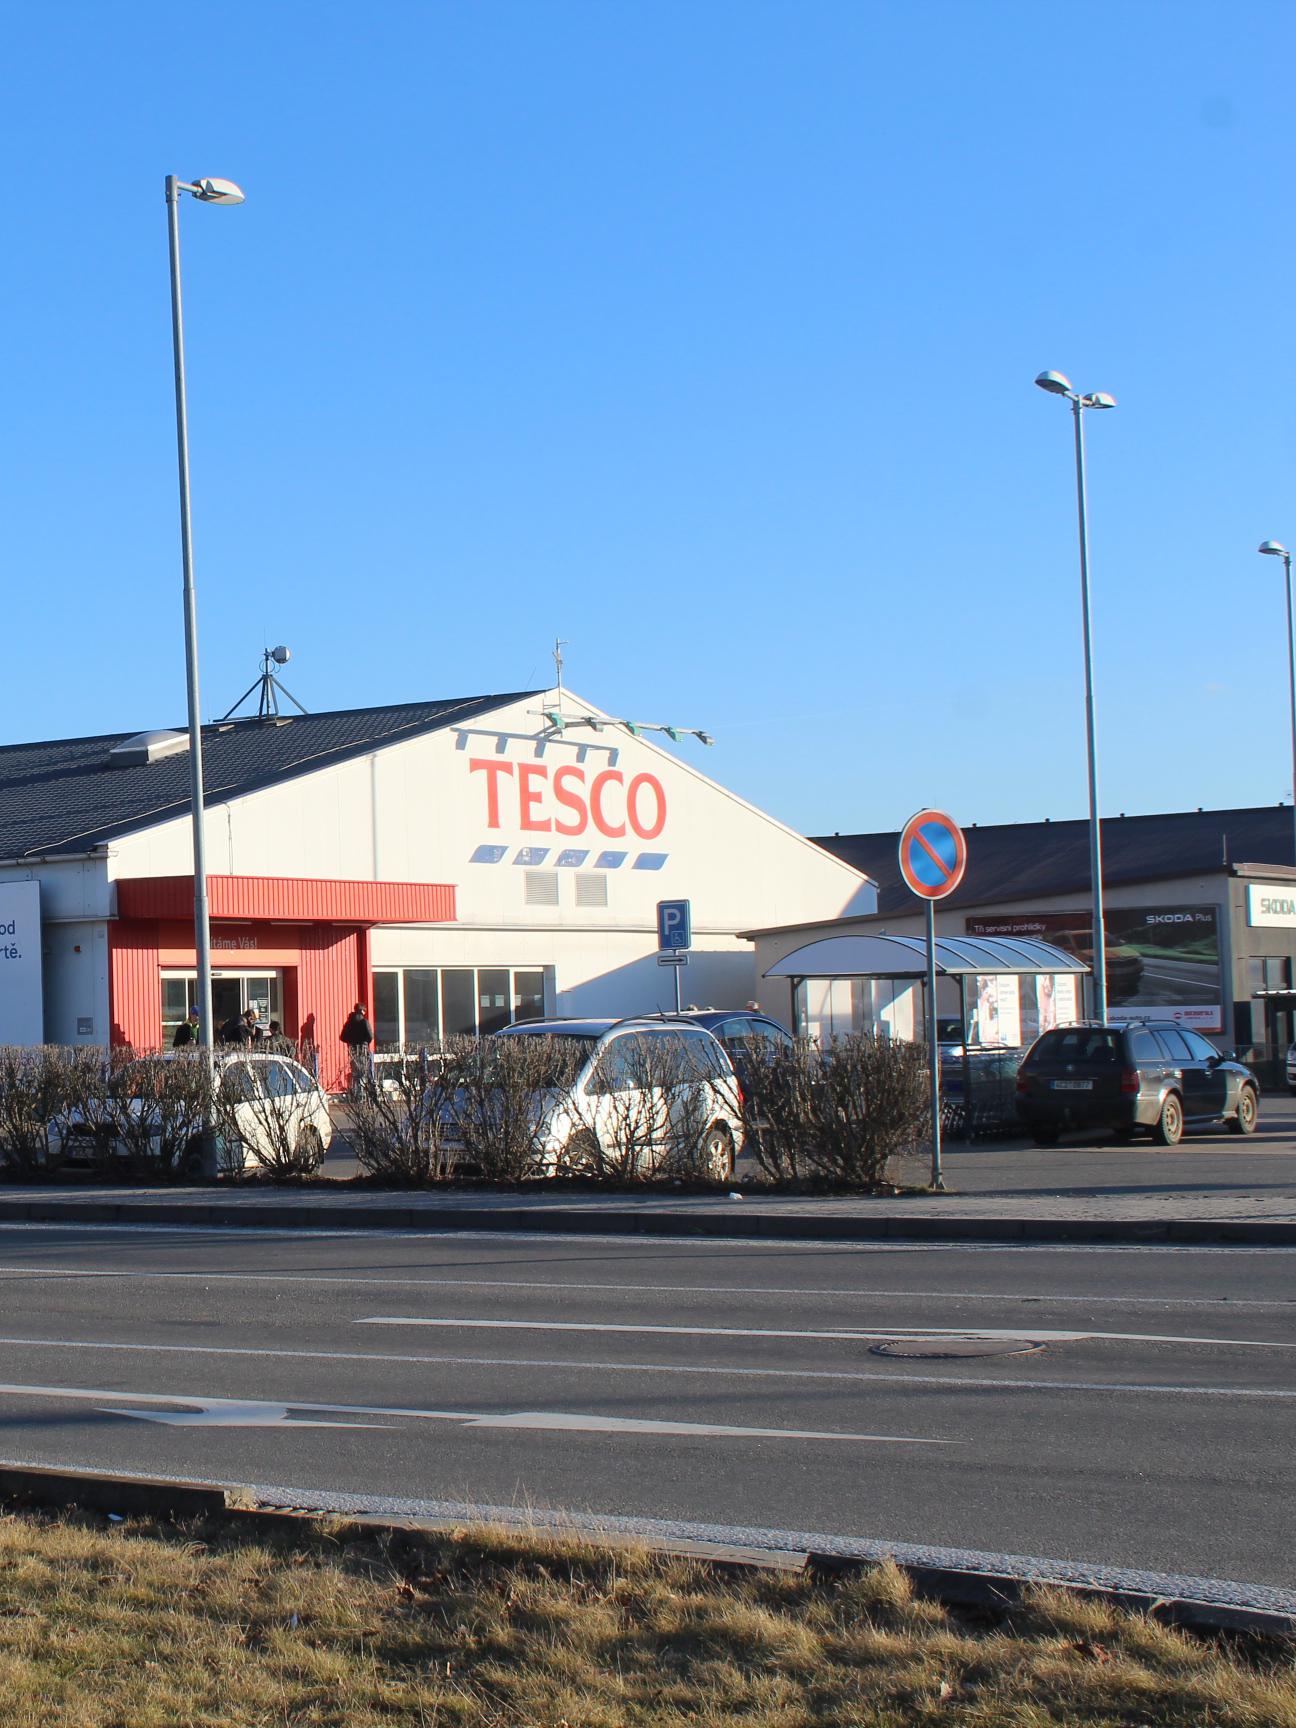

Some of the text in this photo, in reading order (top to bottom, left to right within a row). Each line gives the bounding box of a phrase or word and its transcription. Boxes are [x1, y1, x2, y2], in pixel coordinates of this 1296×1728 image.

[469, 758, 667, 840] TESCO
[664, 909, 680, 935] P
[1195, 913, 1212, 922] Plus
[210, 937, 257, 950] ítáme Vás!
